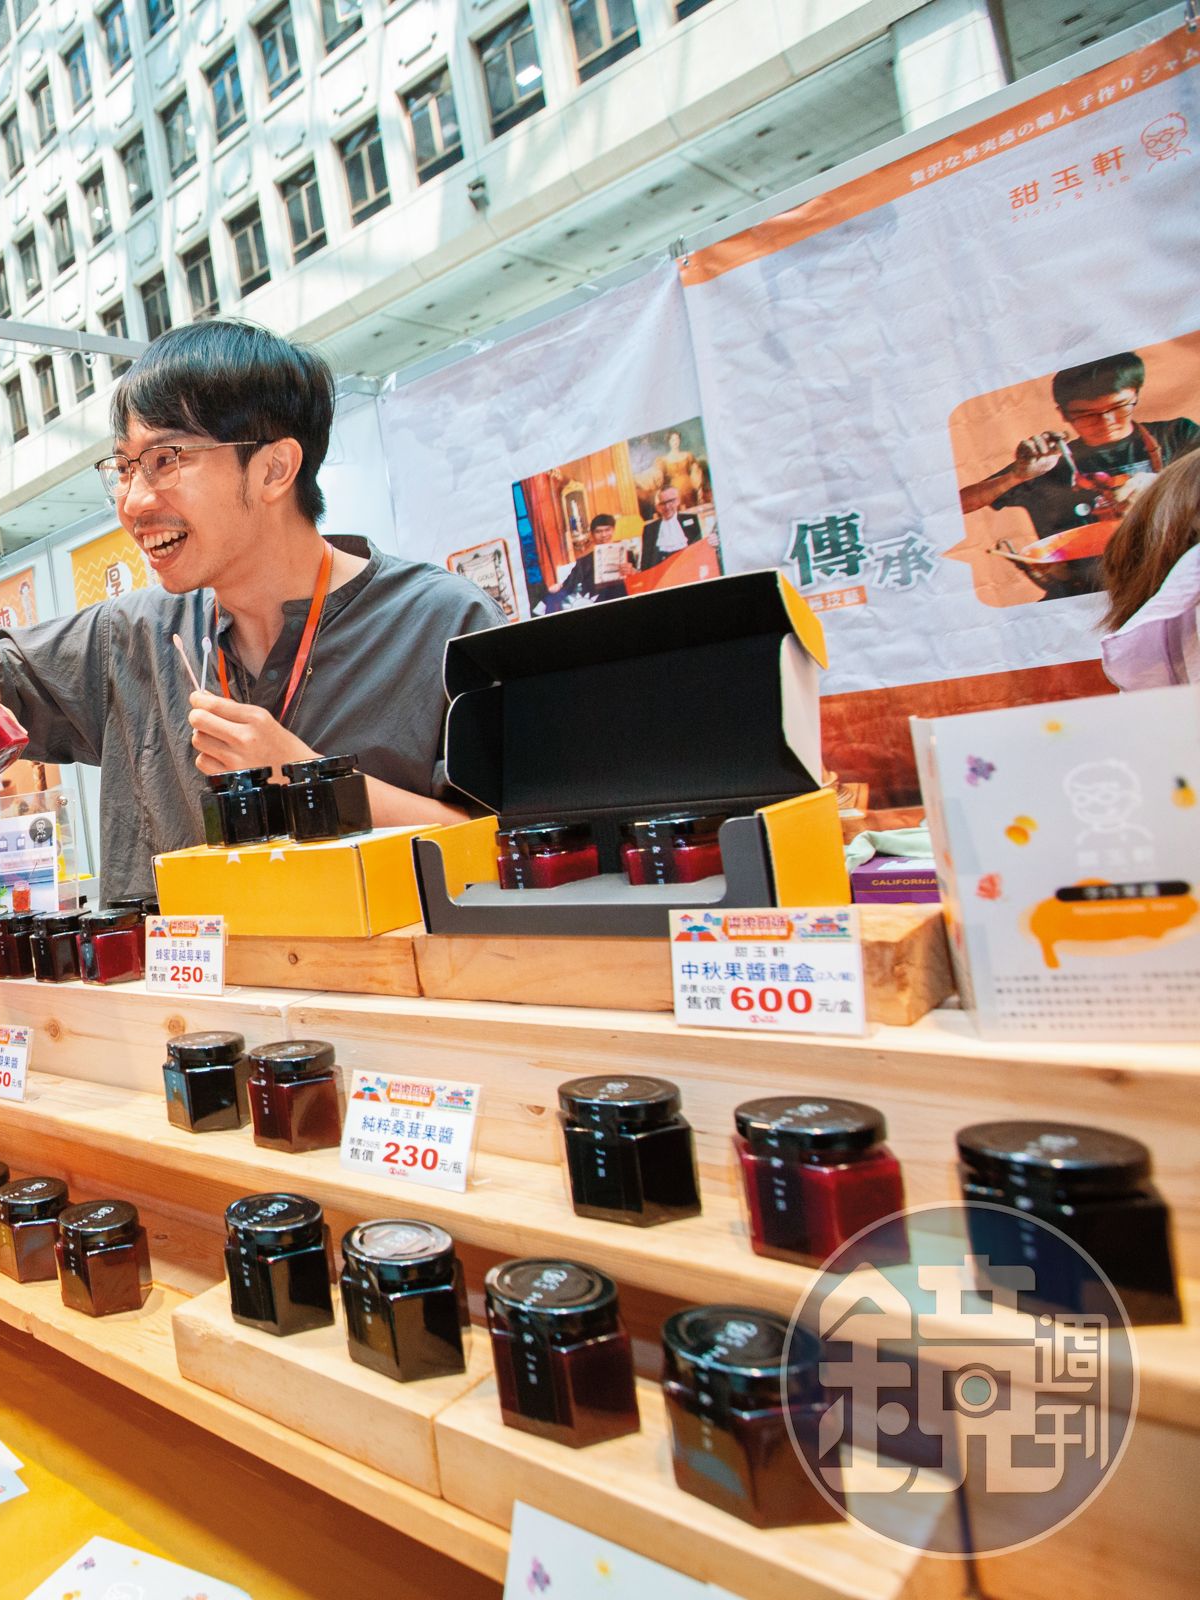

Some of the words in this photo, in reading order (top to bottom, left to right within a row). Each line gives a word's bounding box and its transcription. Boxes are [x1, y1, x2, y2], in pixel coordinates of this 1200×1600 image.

[1008, 145, 1126, 210] 甜玉軒
[788, 510, 937, 589] 傳承
[105, 561, 125, 597] 厚
[871, 878, 937, 887] CALIFORNIA
[170, 965, 203, 983] 250
[681, 961, 816, 983] 中秋果醬禮盒
[686, 996, 722, 1011] 售價
[730, 986, 813, 1014] 600
[817, 999, 852, 1014] 元/盒
[350, 1147, 375, 1162] 售價
[382, 1141, 439, 1171] 230
[439, 1159, 463, 1174] 元/瓶
